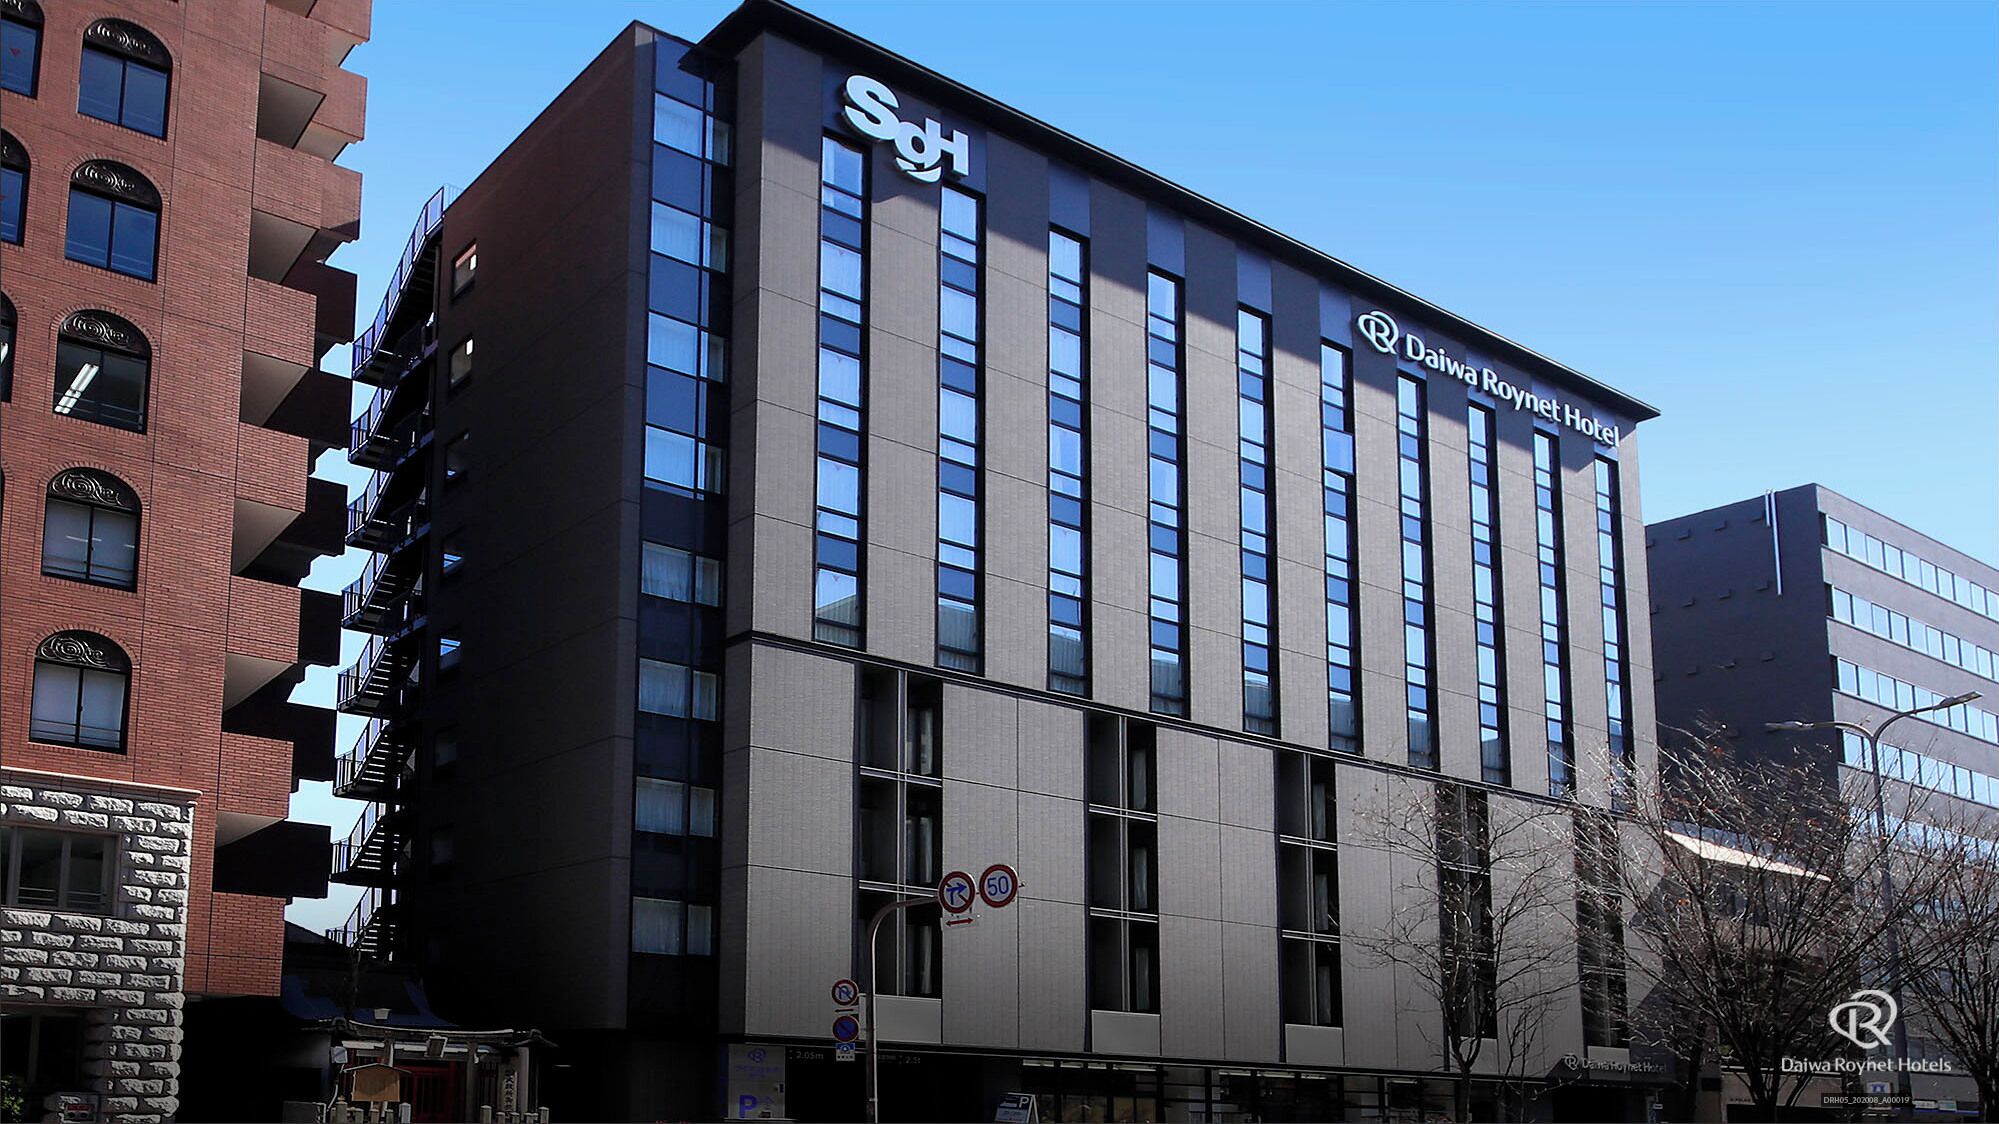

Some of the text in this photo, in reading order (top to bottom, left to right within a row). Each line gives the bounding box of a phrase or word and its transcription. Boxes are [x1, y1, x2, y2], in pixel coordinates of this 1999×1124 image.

[1404, 333, 1478, 386] Daiwa
[1482, 367, 1561, 423] Roynet
[1564, 404, 1620, 448] Hotel
[987, 876, 1009, 896] 50
[739, 1095, 757, 1119] P
[1018, 1096, 1030, 1108] P
